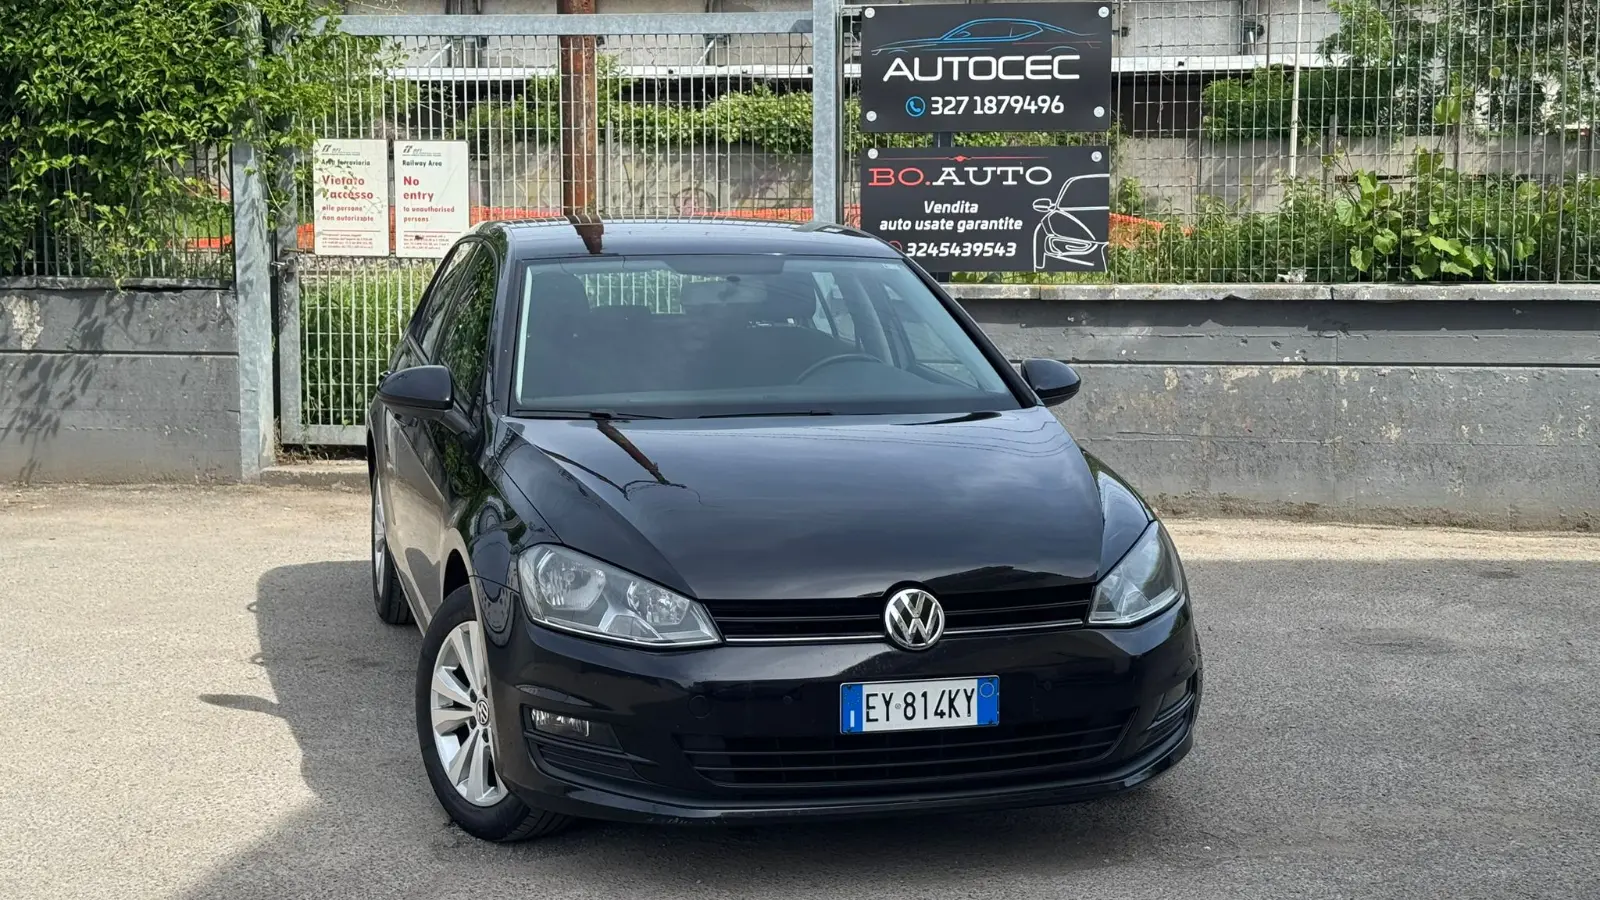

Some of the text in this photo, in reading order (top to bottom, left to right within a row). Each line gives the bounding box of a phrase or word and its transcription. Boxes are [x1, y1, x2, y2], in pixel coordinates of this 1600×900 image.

[882, 54, 1081, 82] AUTOCEC
[930, 95, 1065, 115] 327 1879496
[402, 160, 427, 168] Railway
[321, 174, 365, 186] Vietato
[403, 175, 420, 186] No
[867, 166, 1053, 187] BO.AUTO
[403, 191, 434, 202] entry
[923, 200, 979, 214] Vendita
[879, 217, 1023, 233] auto usate garantite
[906, 242, 1017, 258] 3245439543
